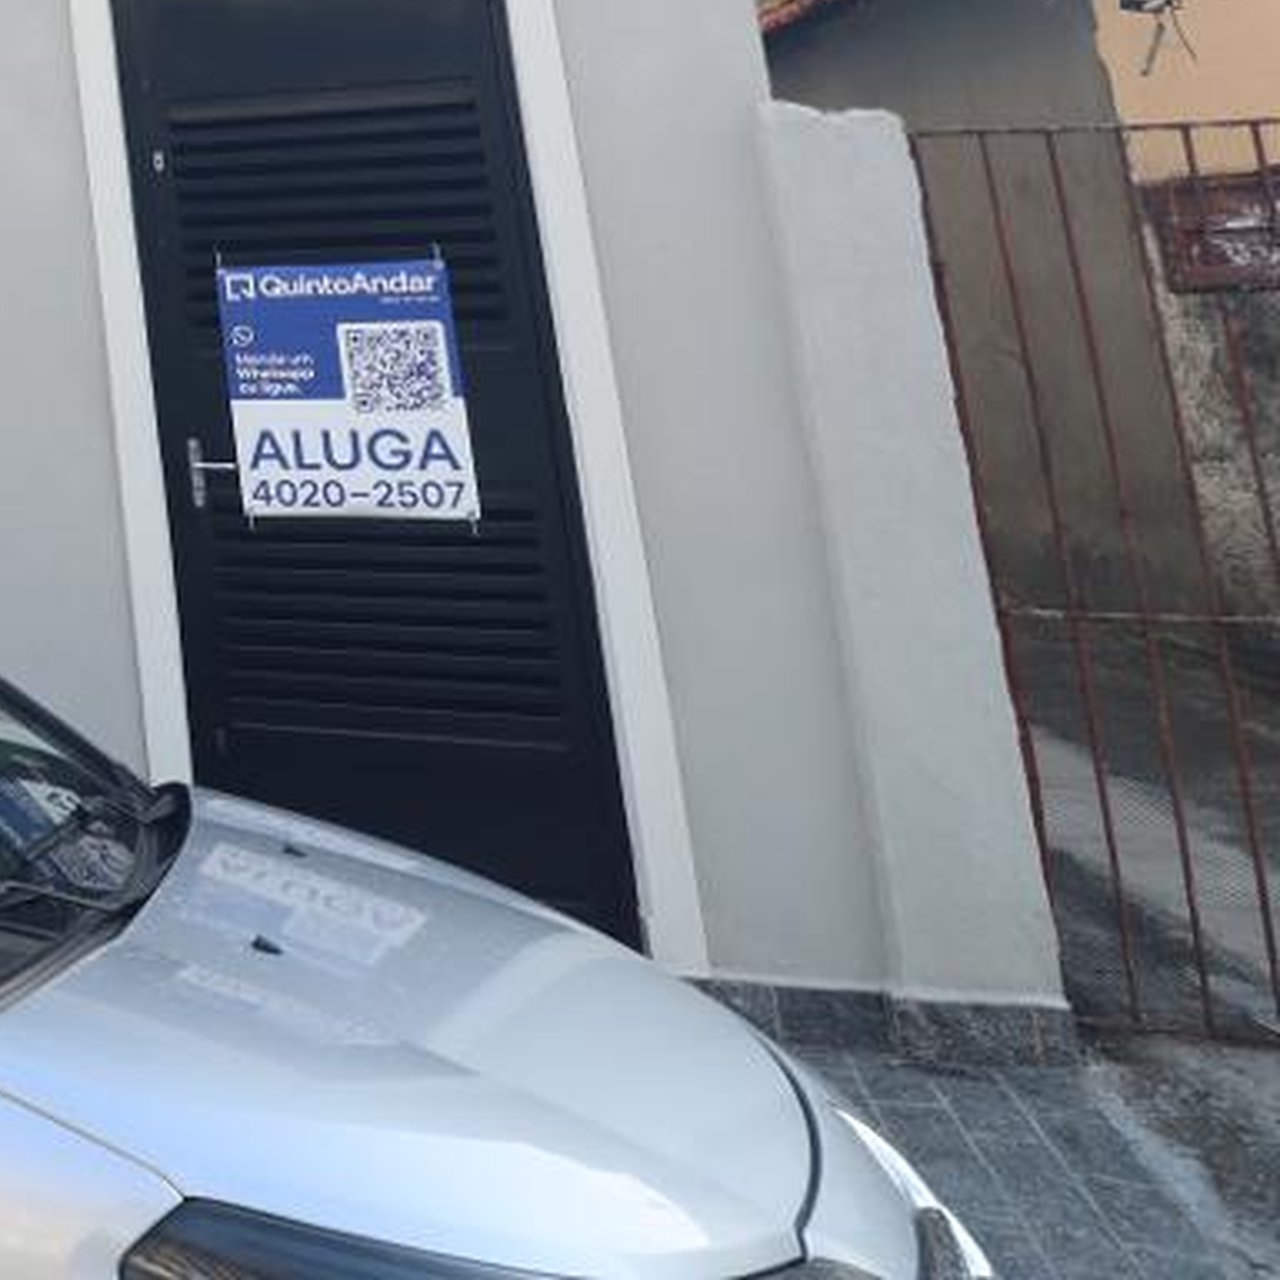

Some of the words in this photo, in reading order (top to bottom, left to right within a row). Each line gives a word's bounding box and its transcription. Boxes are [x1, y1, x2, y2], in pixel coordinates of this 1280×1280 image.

[259, 271, 438, 298] QuintoAndar
[250, 428, 462, 471] ALUGA
[252, 479, 466, 508] 4020-2507
